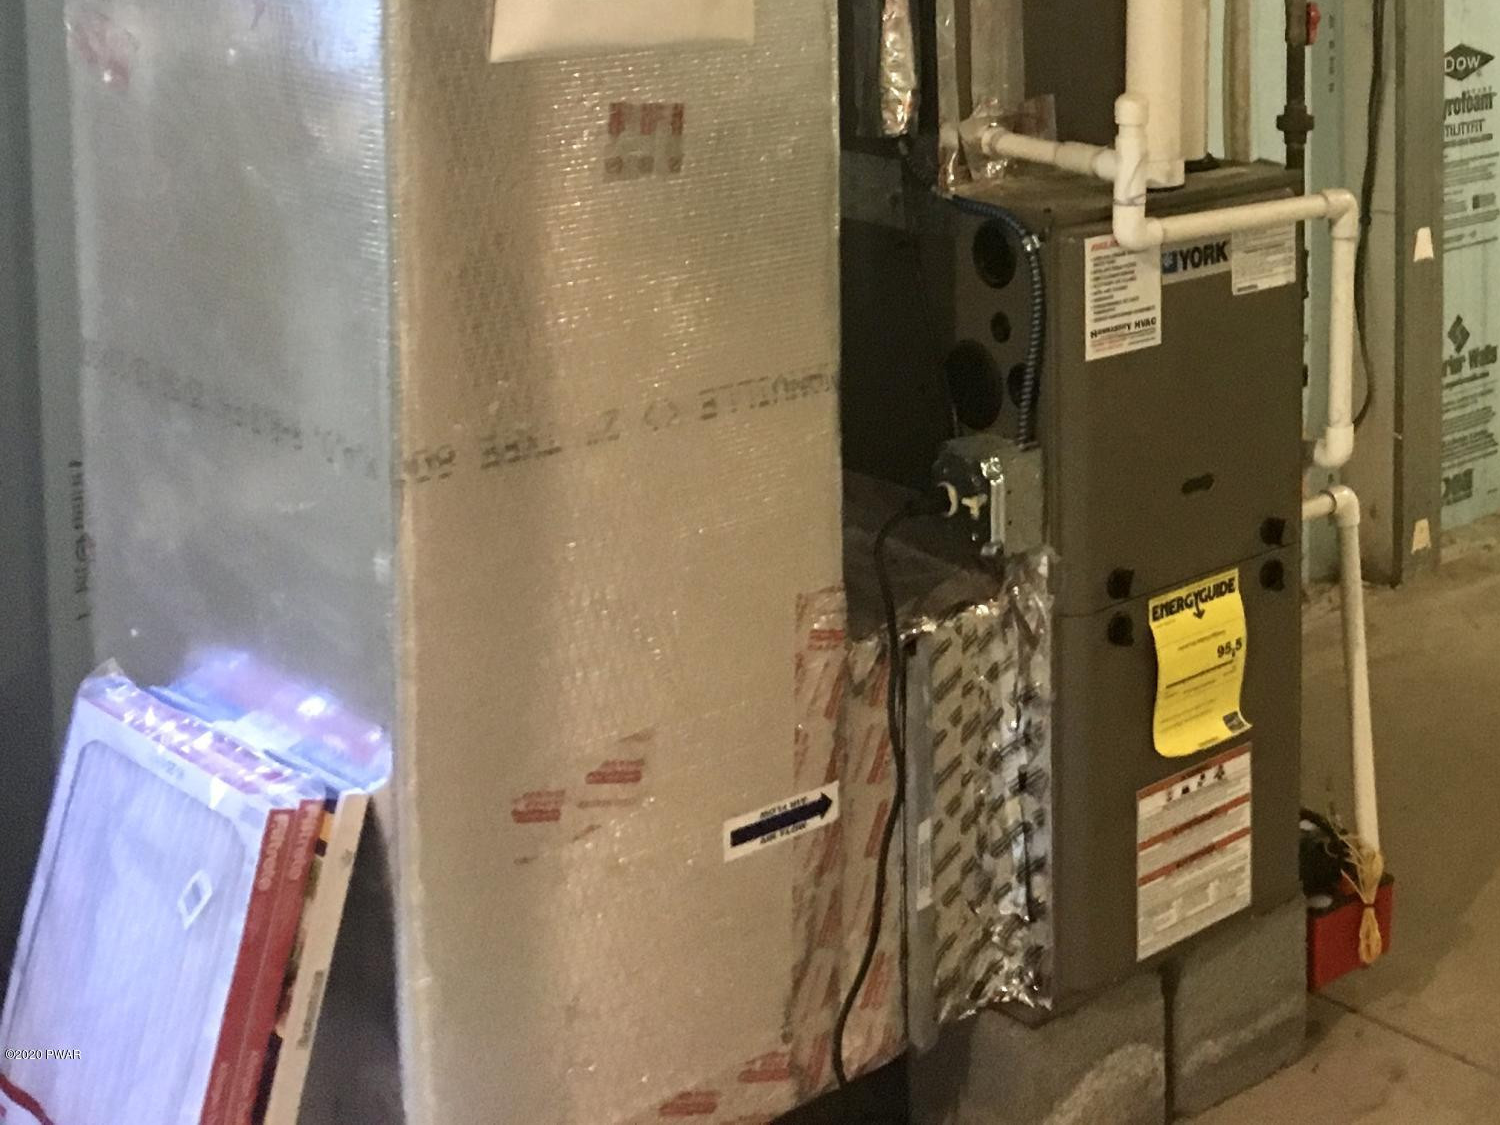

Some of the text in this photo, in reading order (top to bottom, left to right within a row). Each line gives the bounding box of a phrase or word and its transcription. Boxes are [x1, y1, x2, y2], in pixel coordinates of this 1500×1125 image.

[1445, 55, 1481, 72] DOW
[1179, 241, 1229, 271] YORK
[1134, 317, 1157, 331] HVAC
[1152, 578, 1236, 622] ENERGYGUIDE
